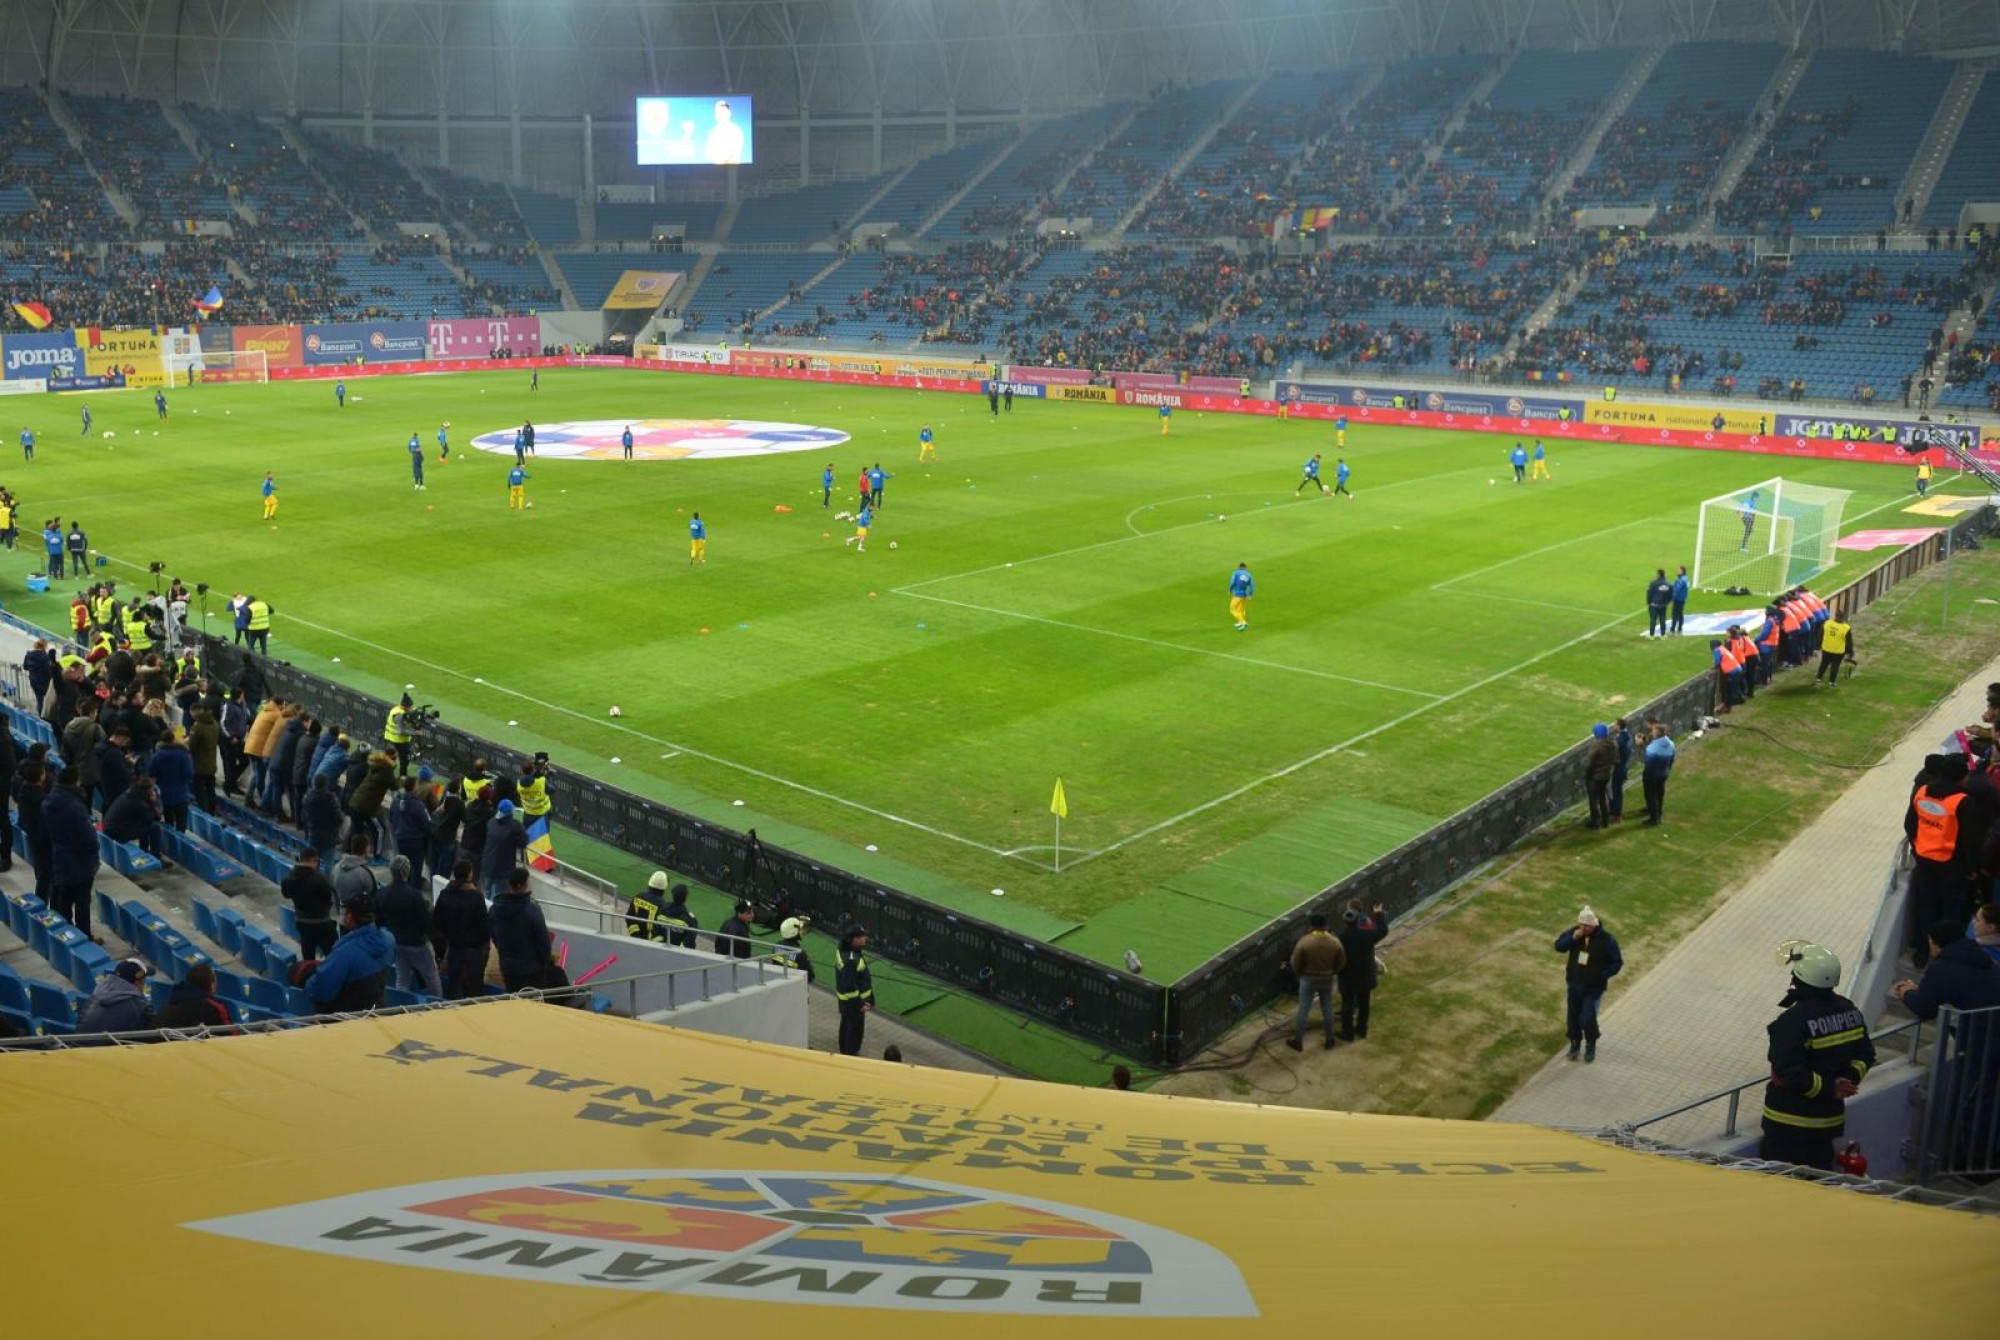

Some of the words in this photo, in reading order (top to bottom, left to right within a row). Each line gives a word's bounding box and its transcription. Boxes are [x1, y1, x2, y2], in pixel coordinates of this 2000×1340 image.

[320, 342, 357, 352] Bancpost
[1064, 386, 1107, 401] ROMÂNIA
[1444, 402, 1488, 415] Bancpost
[1594, 409, 1656, 422] FORTUNA
[679, 1076, 1096, 1144] FOTBAL
[572, 1101, 1319, 1188] ROMÂNIA
[1125, 1134, 1275, 1157] DE
[1102, 1147, 1608, 1177] ECHIPA
[318, 1215, 1142, 1305] ROMÂNIA
